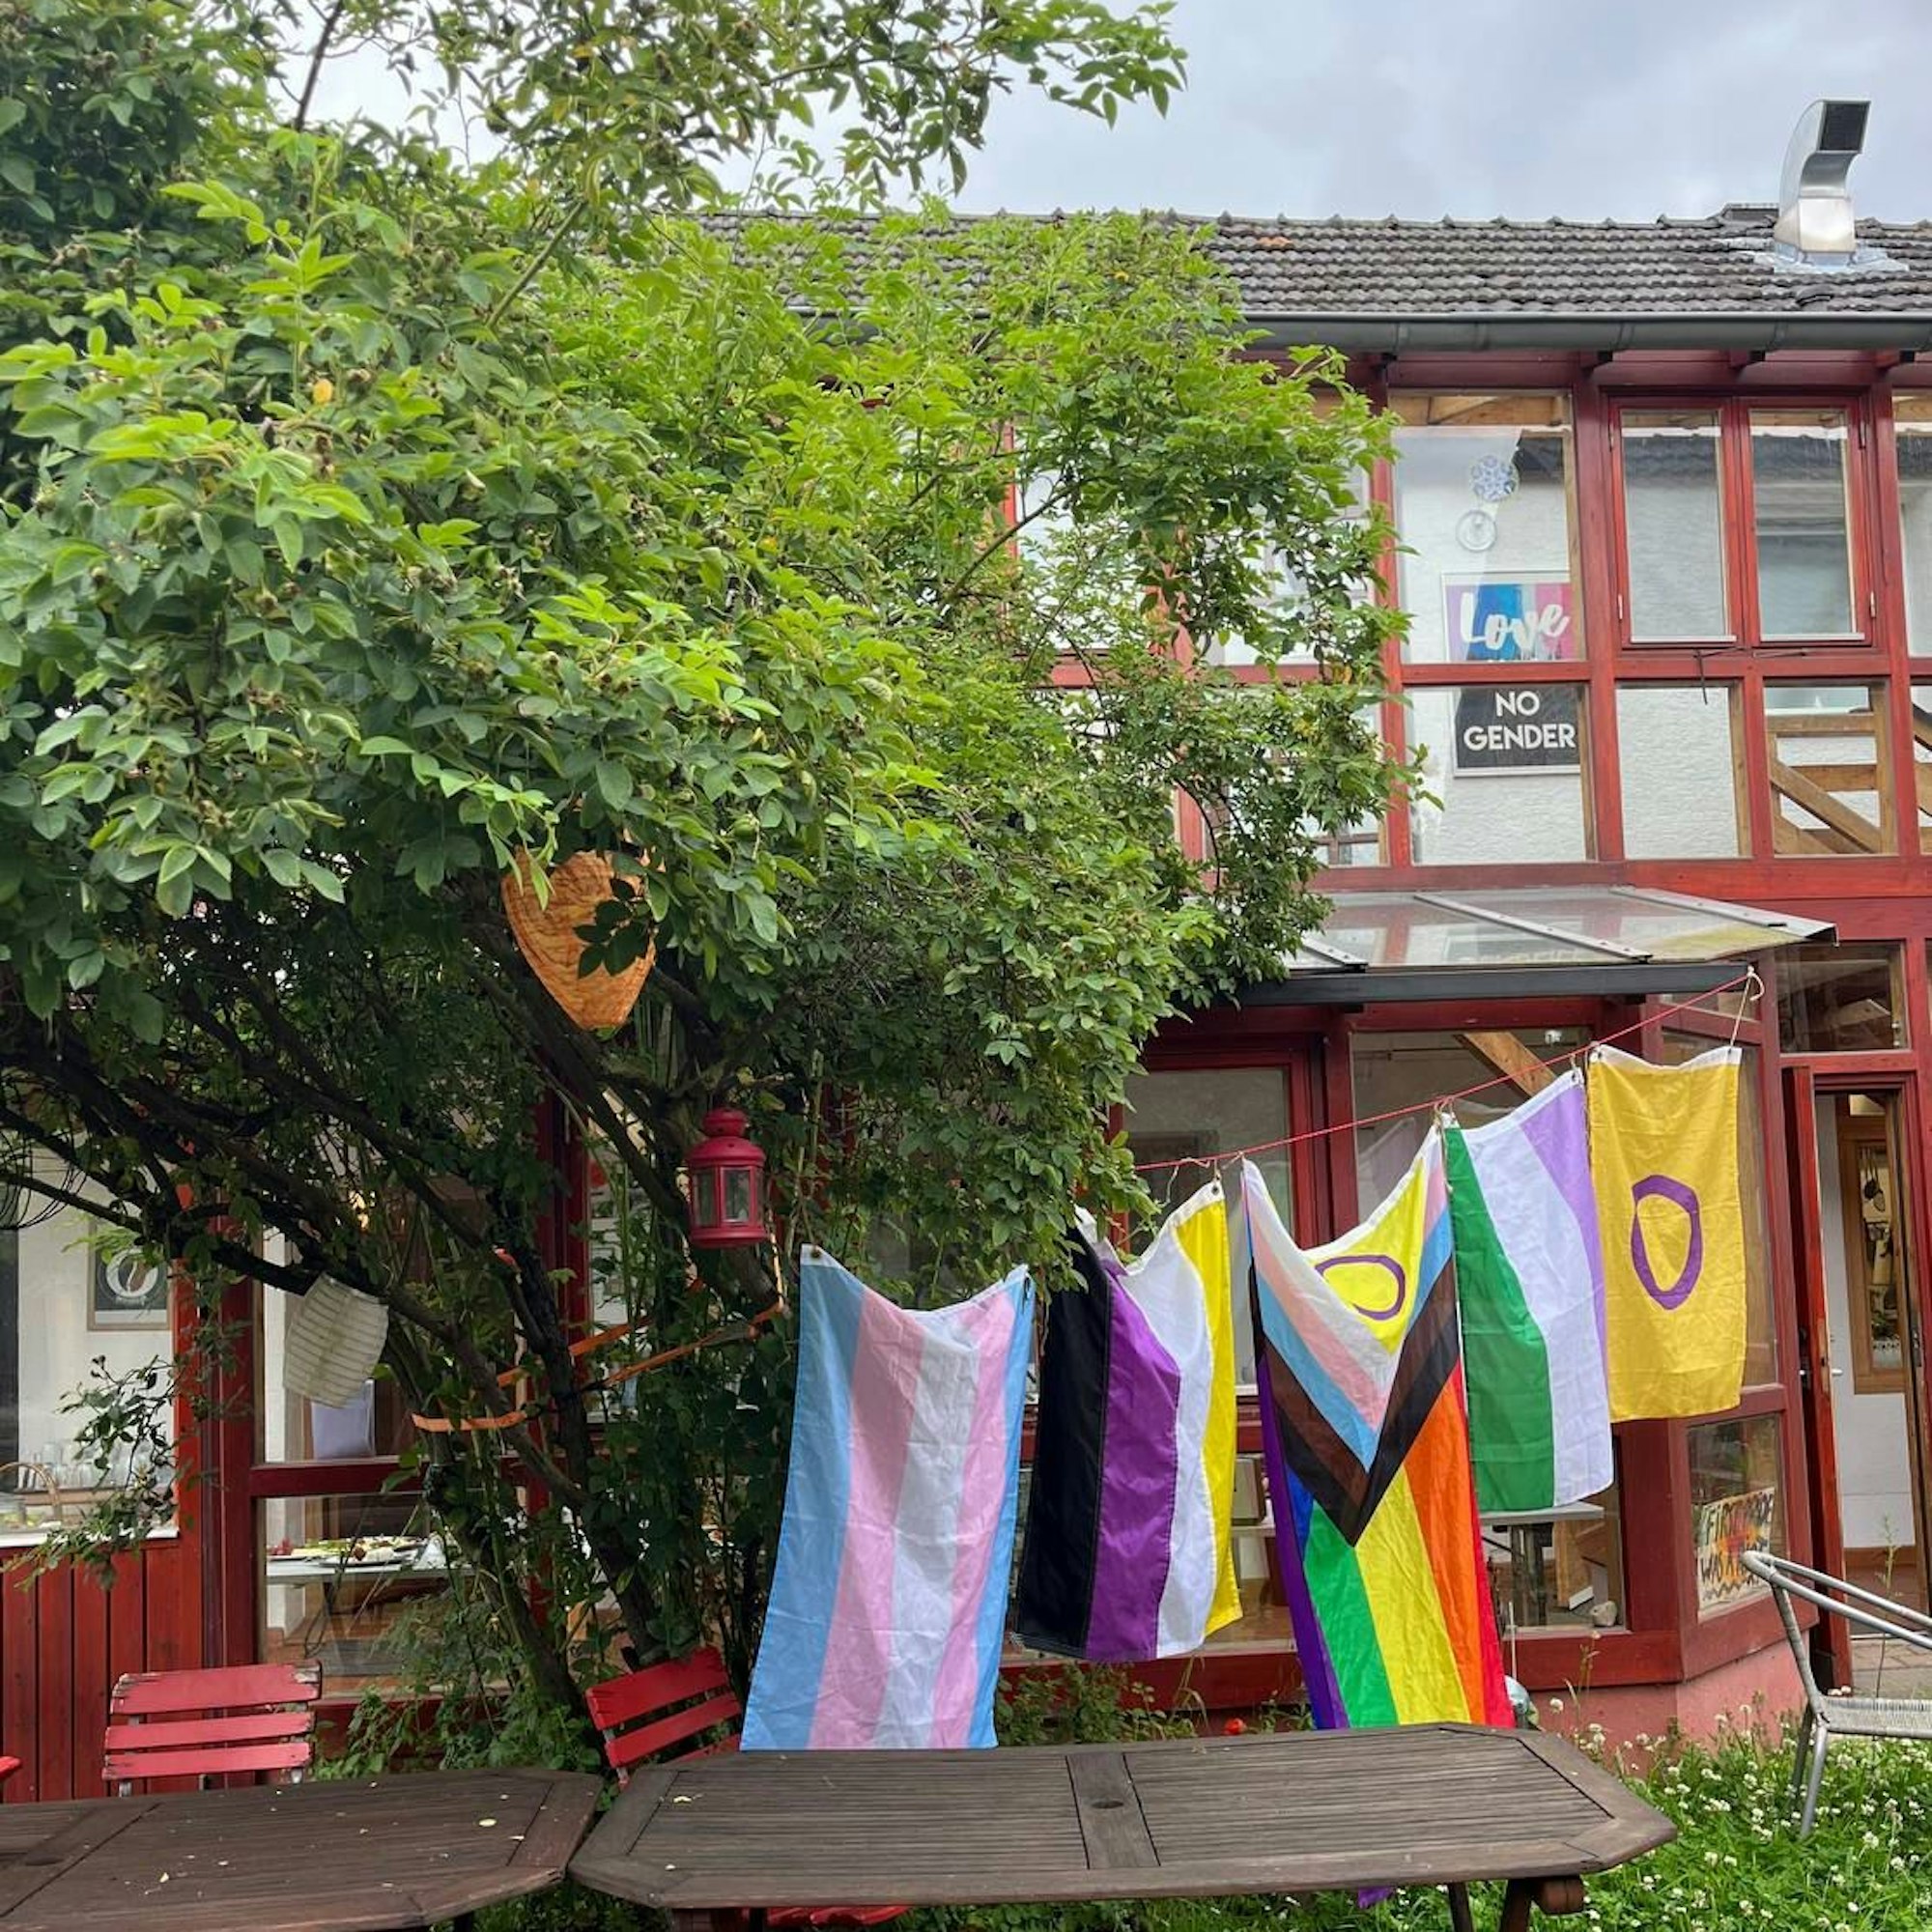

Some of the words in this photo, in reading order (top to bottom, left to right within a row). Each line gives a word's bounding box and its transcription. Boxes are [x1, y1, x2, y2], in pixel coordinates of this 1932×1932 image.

[1460, 591, 1570, 651] Love
[1495, 691, 1541, 717] NO
[1463, 723, 1577, 751] GENDER
